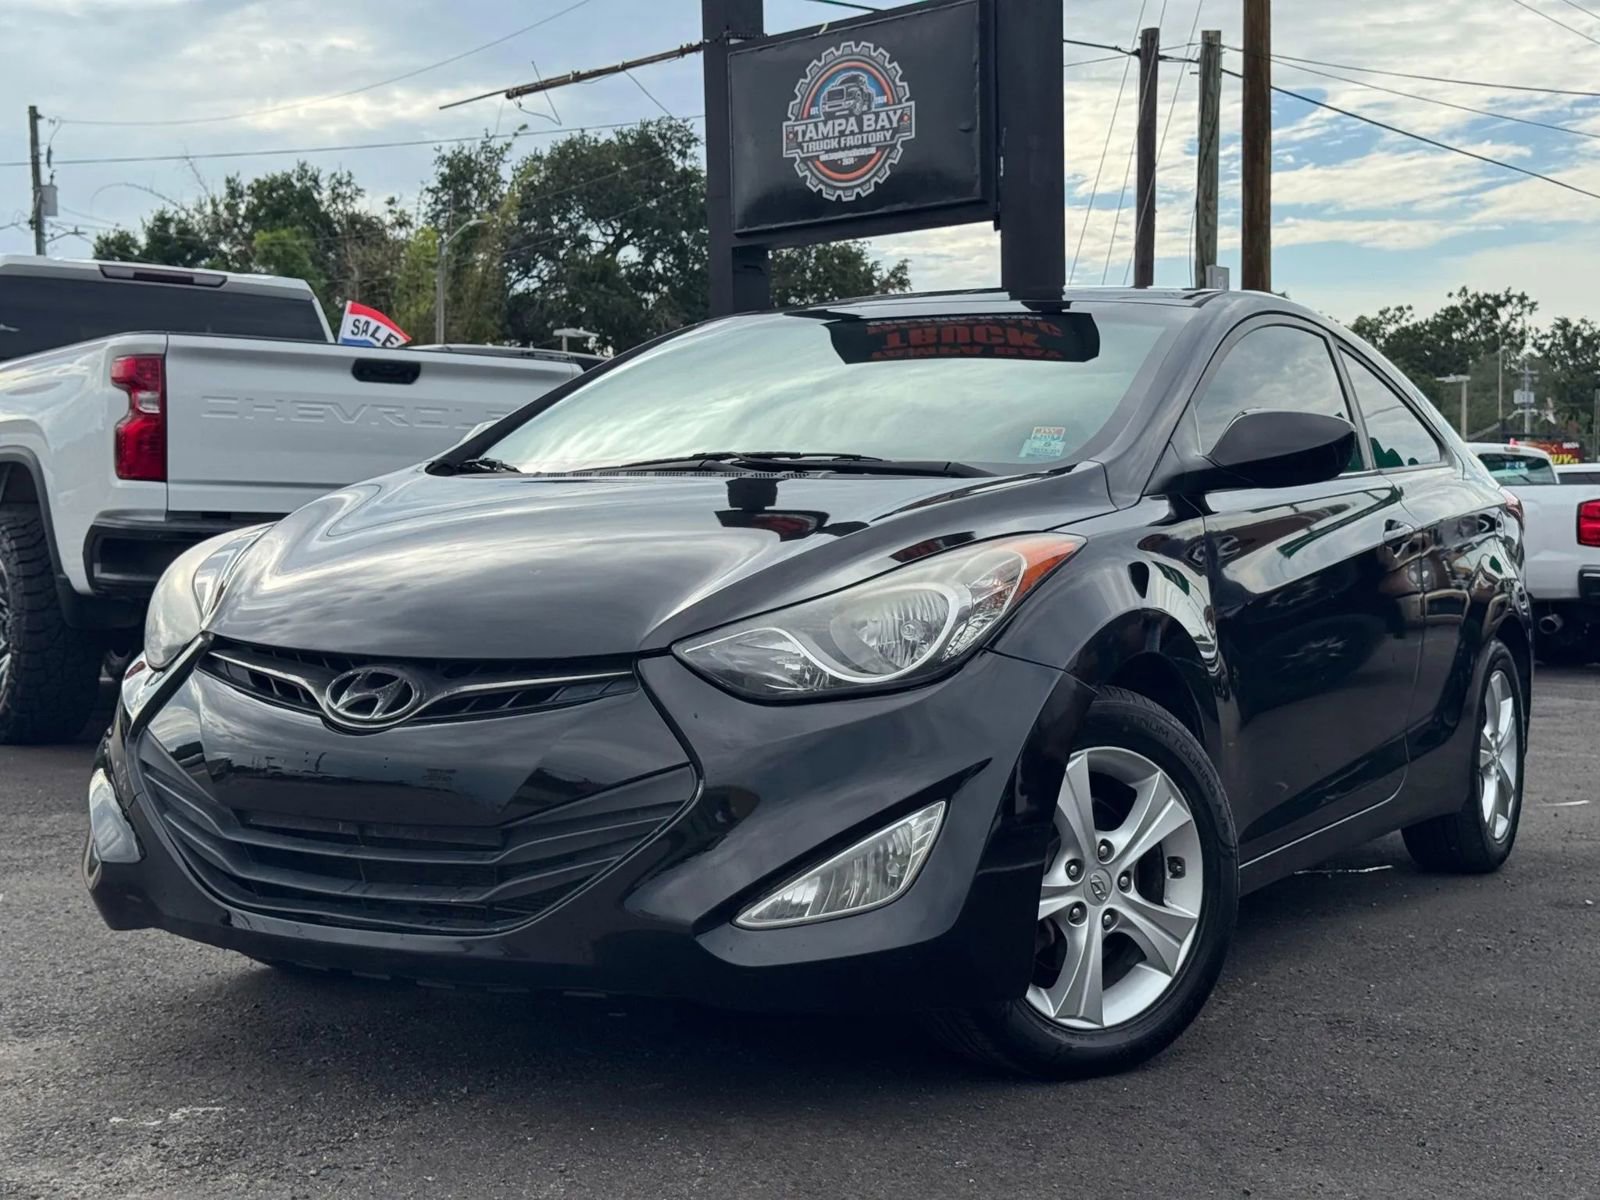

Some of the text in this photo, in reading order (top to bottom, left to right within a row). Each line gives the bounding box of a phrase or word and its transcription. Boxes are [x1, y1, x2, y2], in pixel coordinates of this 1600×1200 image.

[794, 110, 903, 142] TAMPA BAY
[802, 129, 893, 153] TRUCK FACTORY
[350, 318, 400, 347] SALE
[201, 397, 508, 429] CHEVROL
